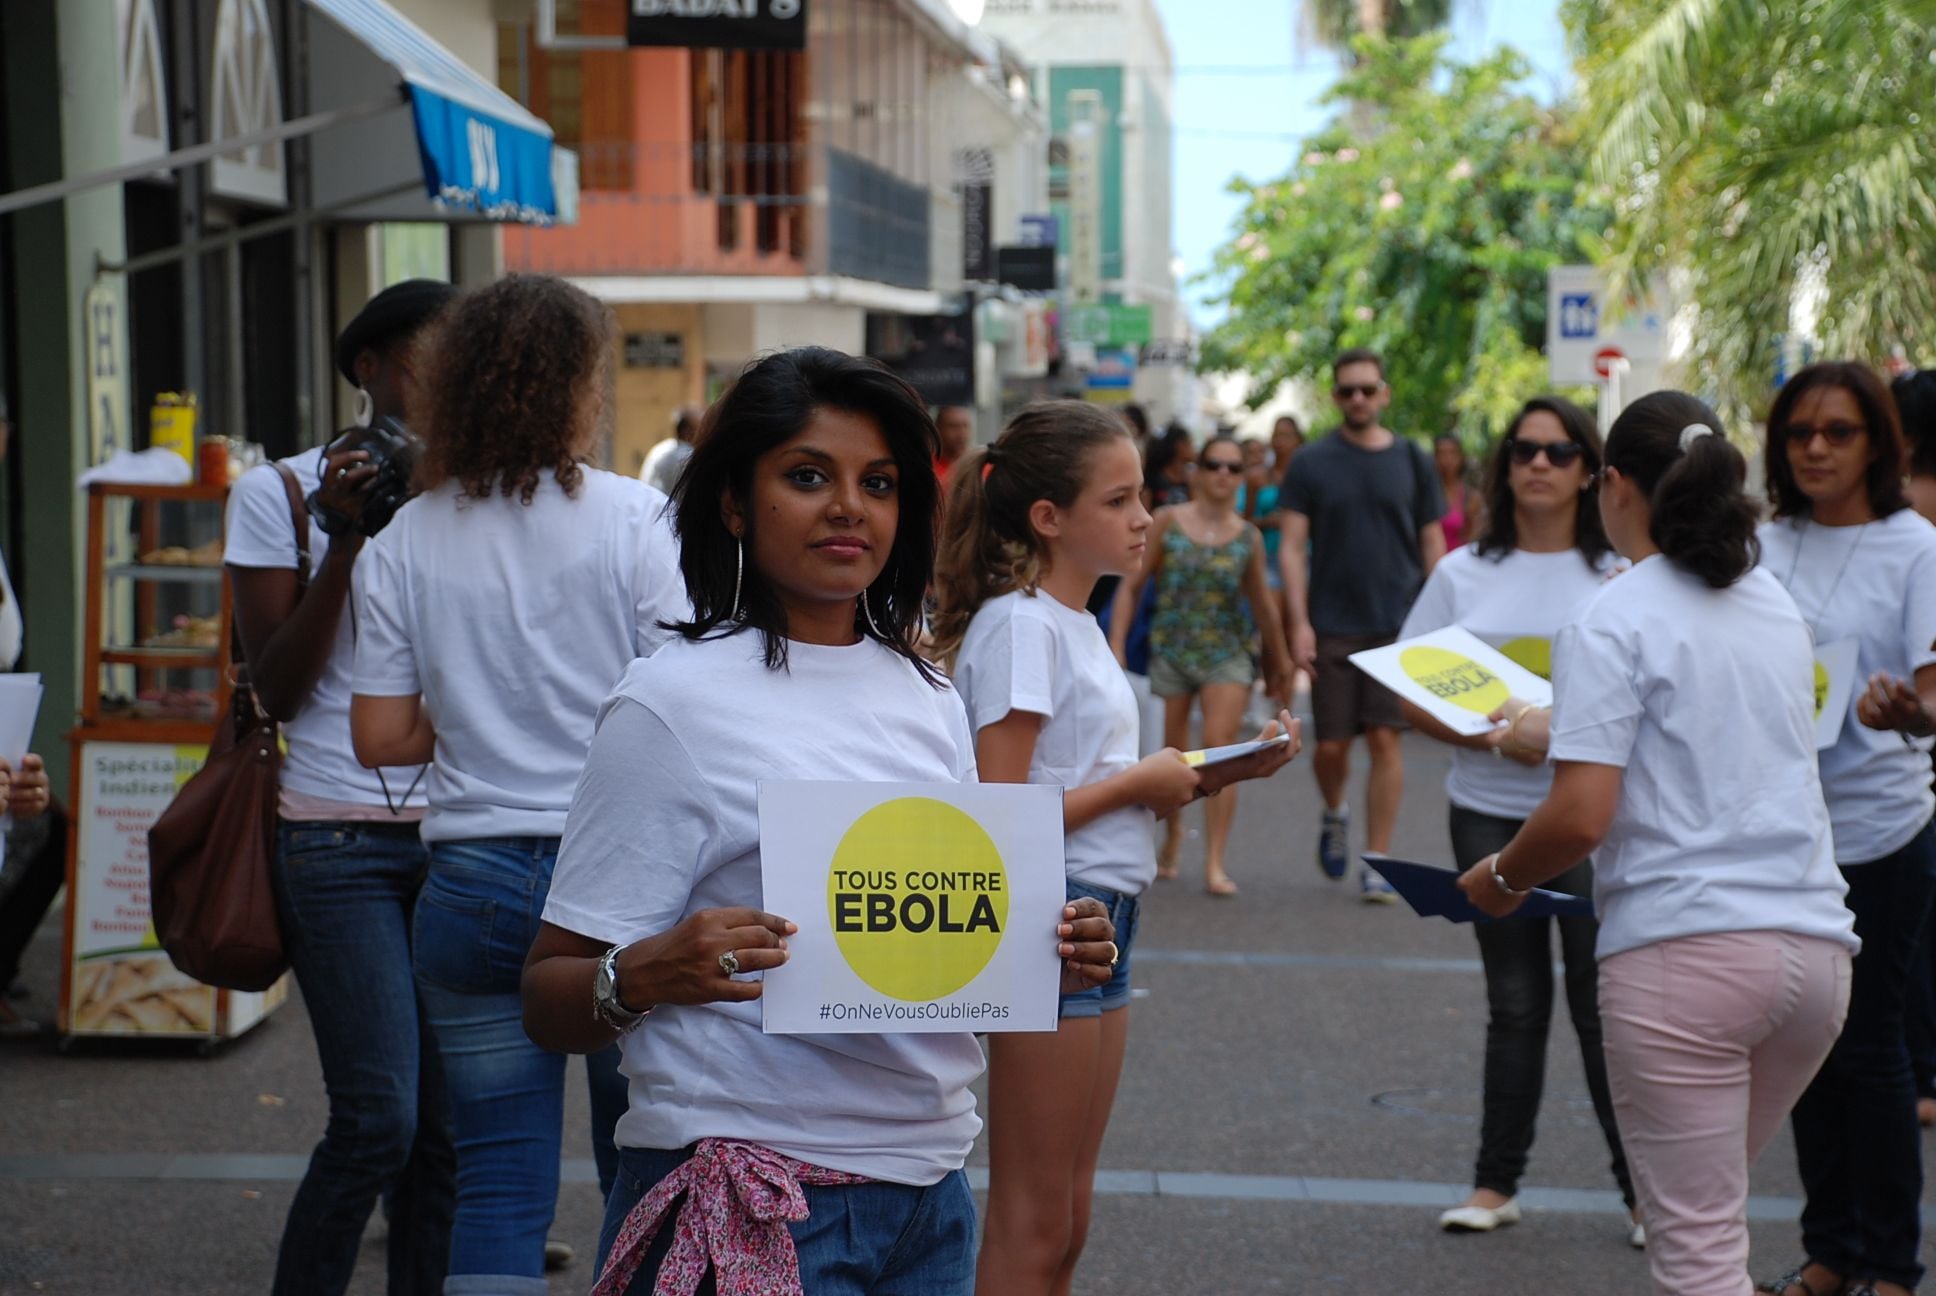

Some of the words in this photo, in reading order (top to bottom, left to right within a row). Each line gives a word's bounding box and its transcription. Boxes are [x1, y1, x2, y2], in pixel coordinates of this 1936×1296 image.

[1426, 668, 1498, 699] EBOLA
[100, 777, 178, 796] Indien
[833, 870, 897, 890] TOUS
[905, 871, 1001, 891] CONTRE
[835, 892, 1000, 934] EBOLA
[819, 1002, 1010, 1021] #OnNeVousOubliePas
